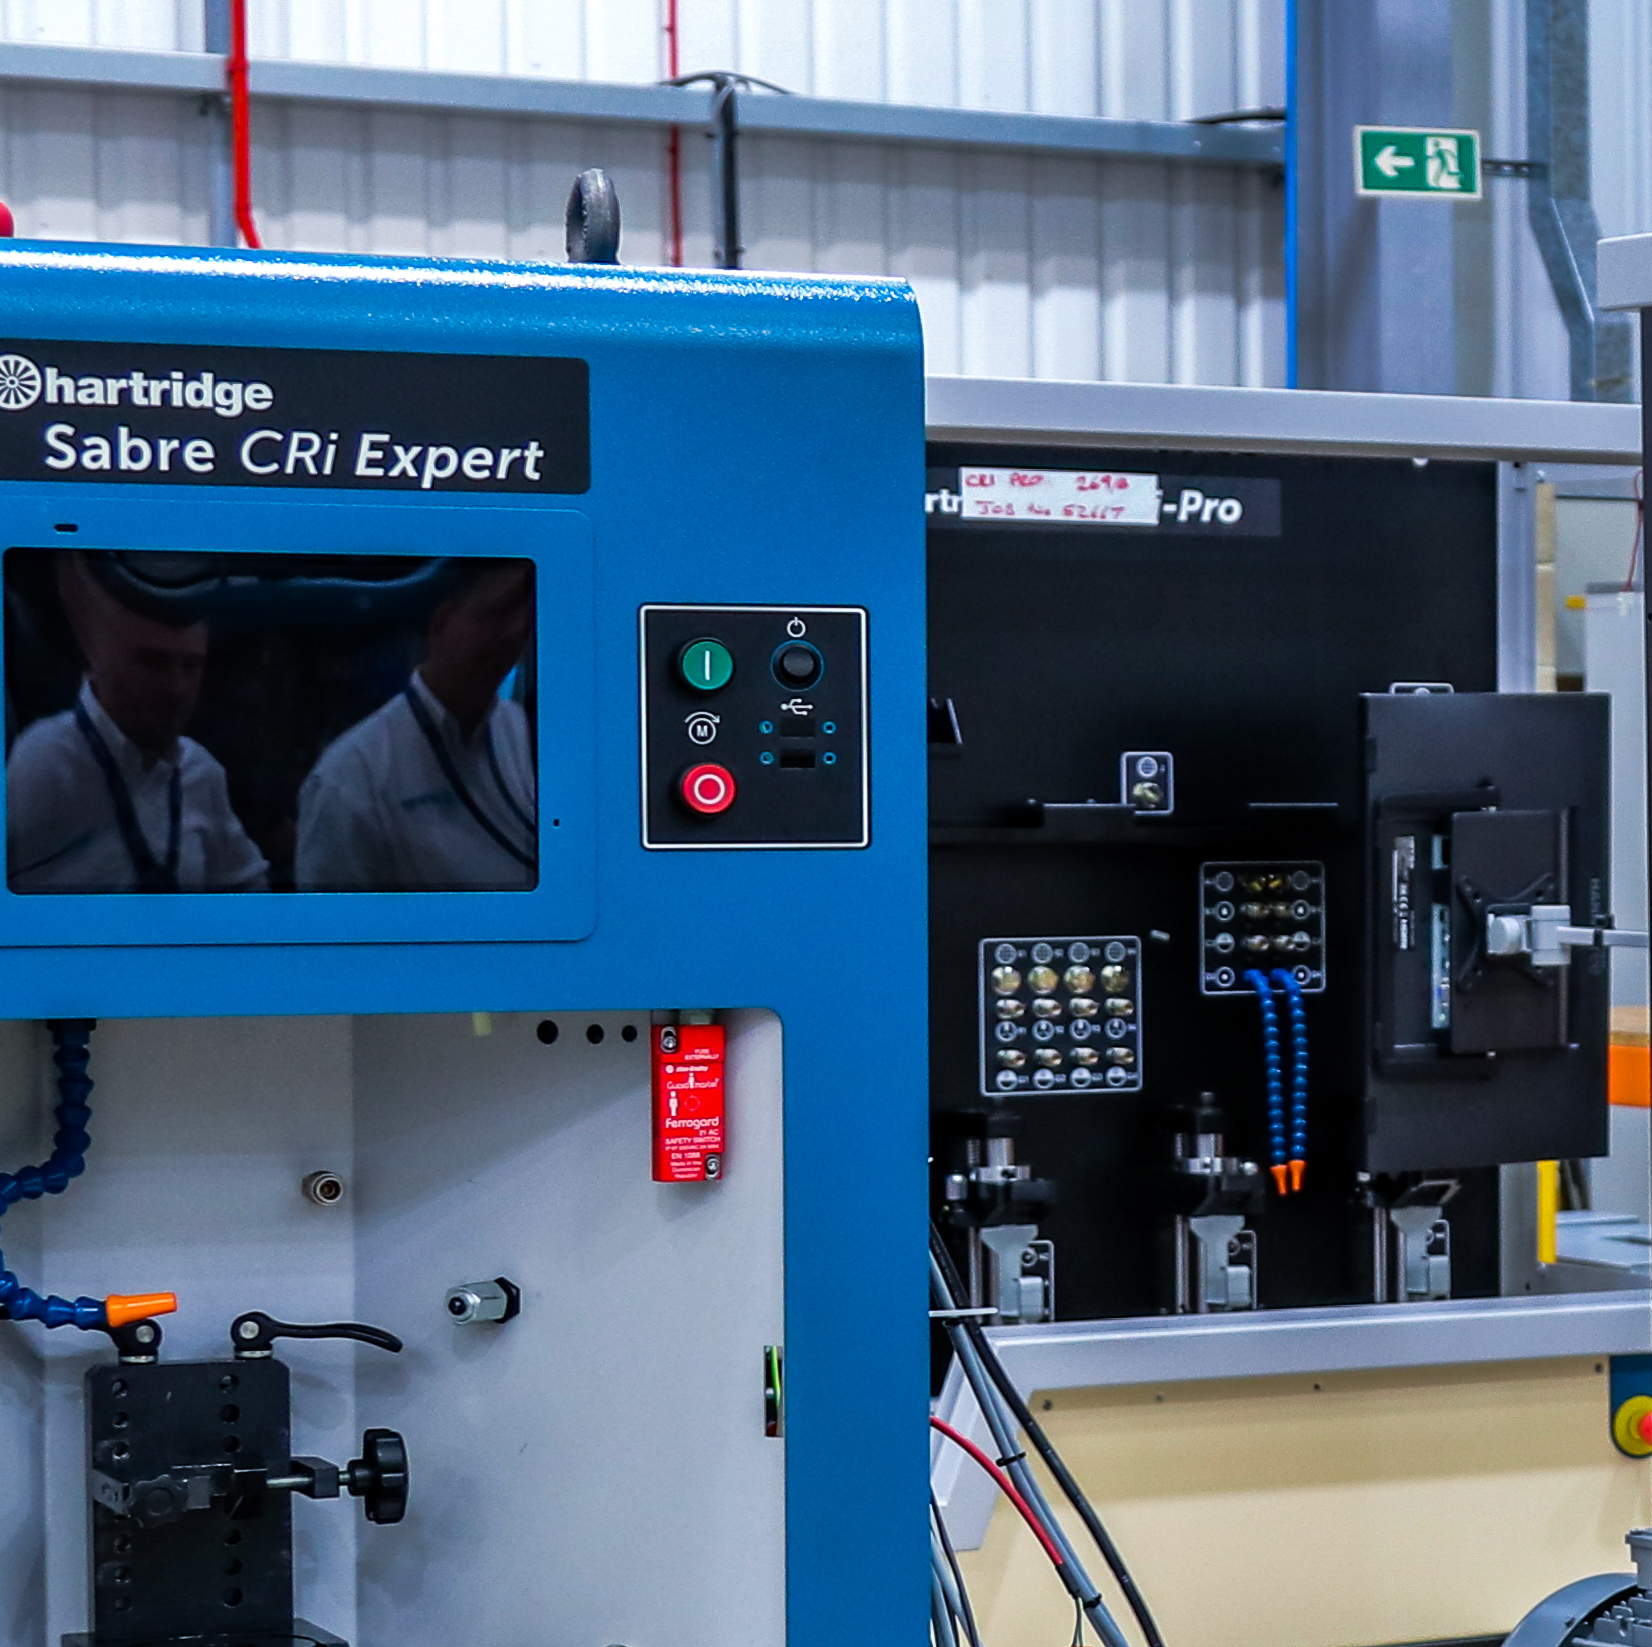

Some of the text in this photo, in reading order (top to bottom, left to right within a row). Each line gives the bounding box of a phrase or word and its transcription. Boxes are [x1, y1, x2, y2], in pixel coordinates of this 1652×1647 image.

[45, 366, 274, 418] hartridge
[44, 423, 545, 490] Sabre CRi Expert
[665, 1116, 720, 1129] Ferrogard
